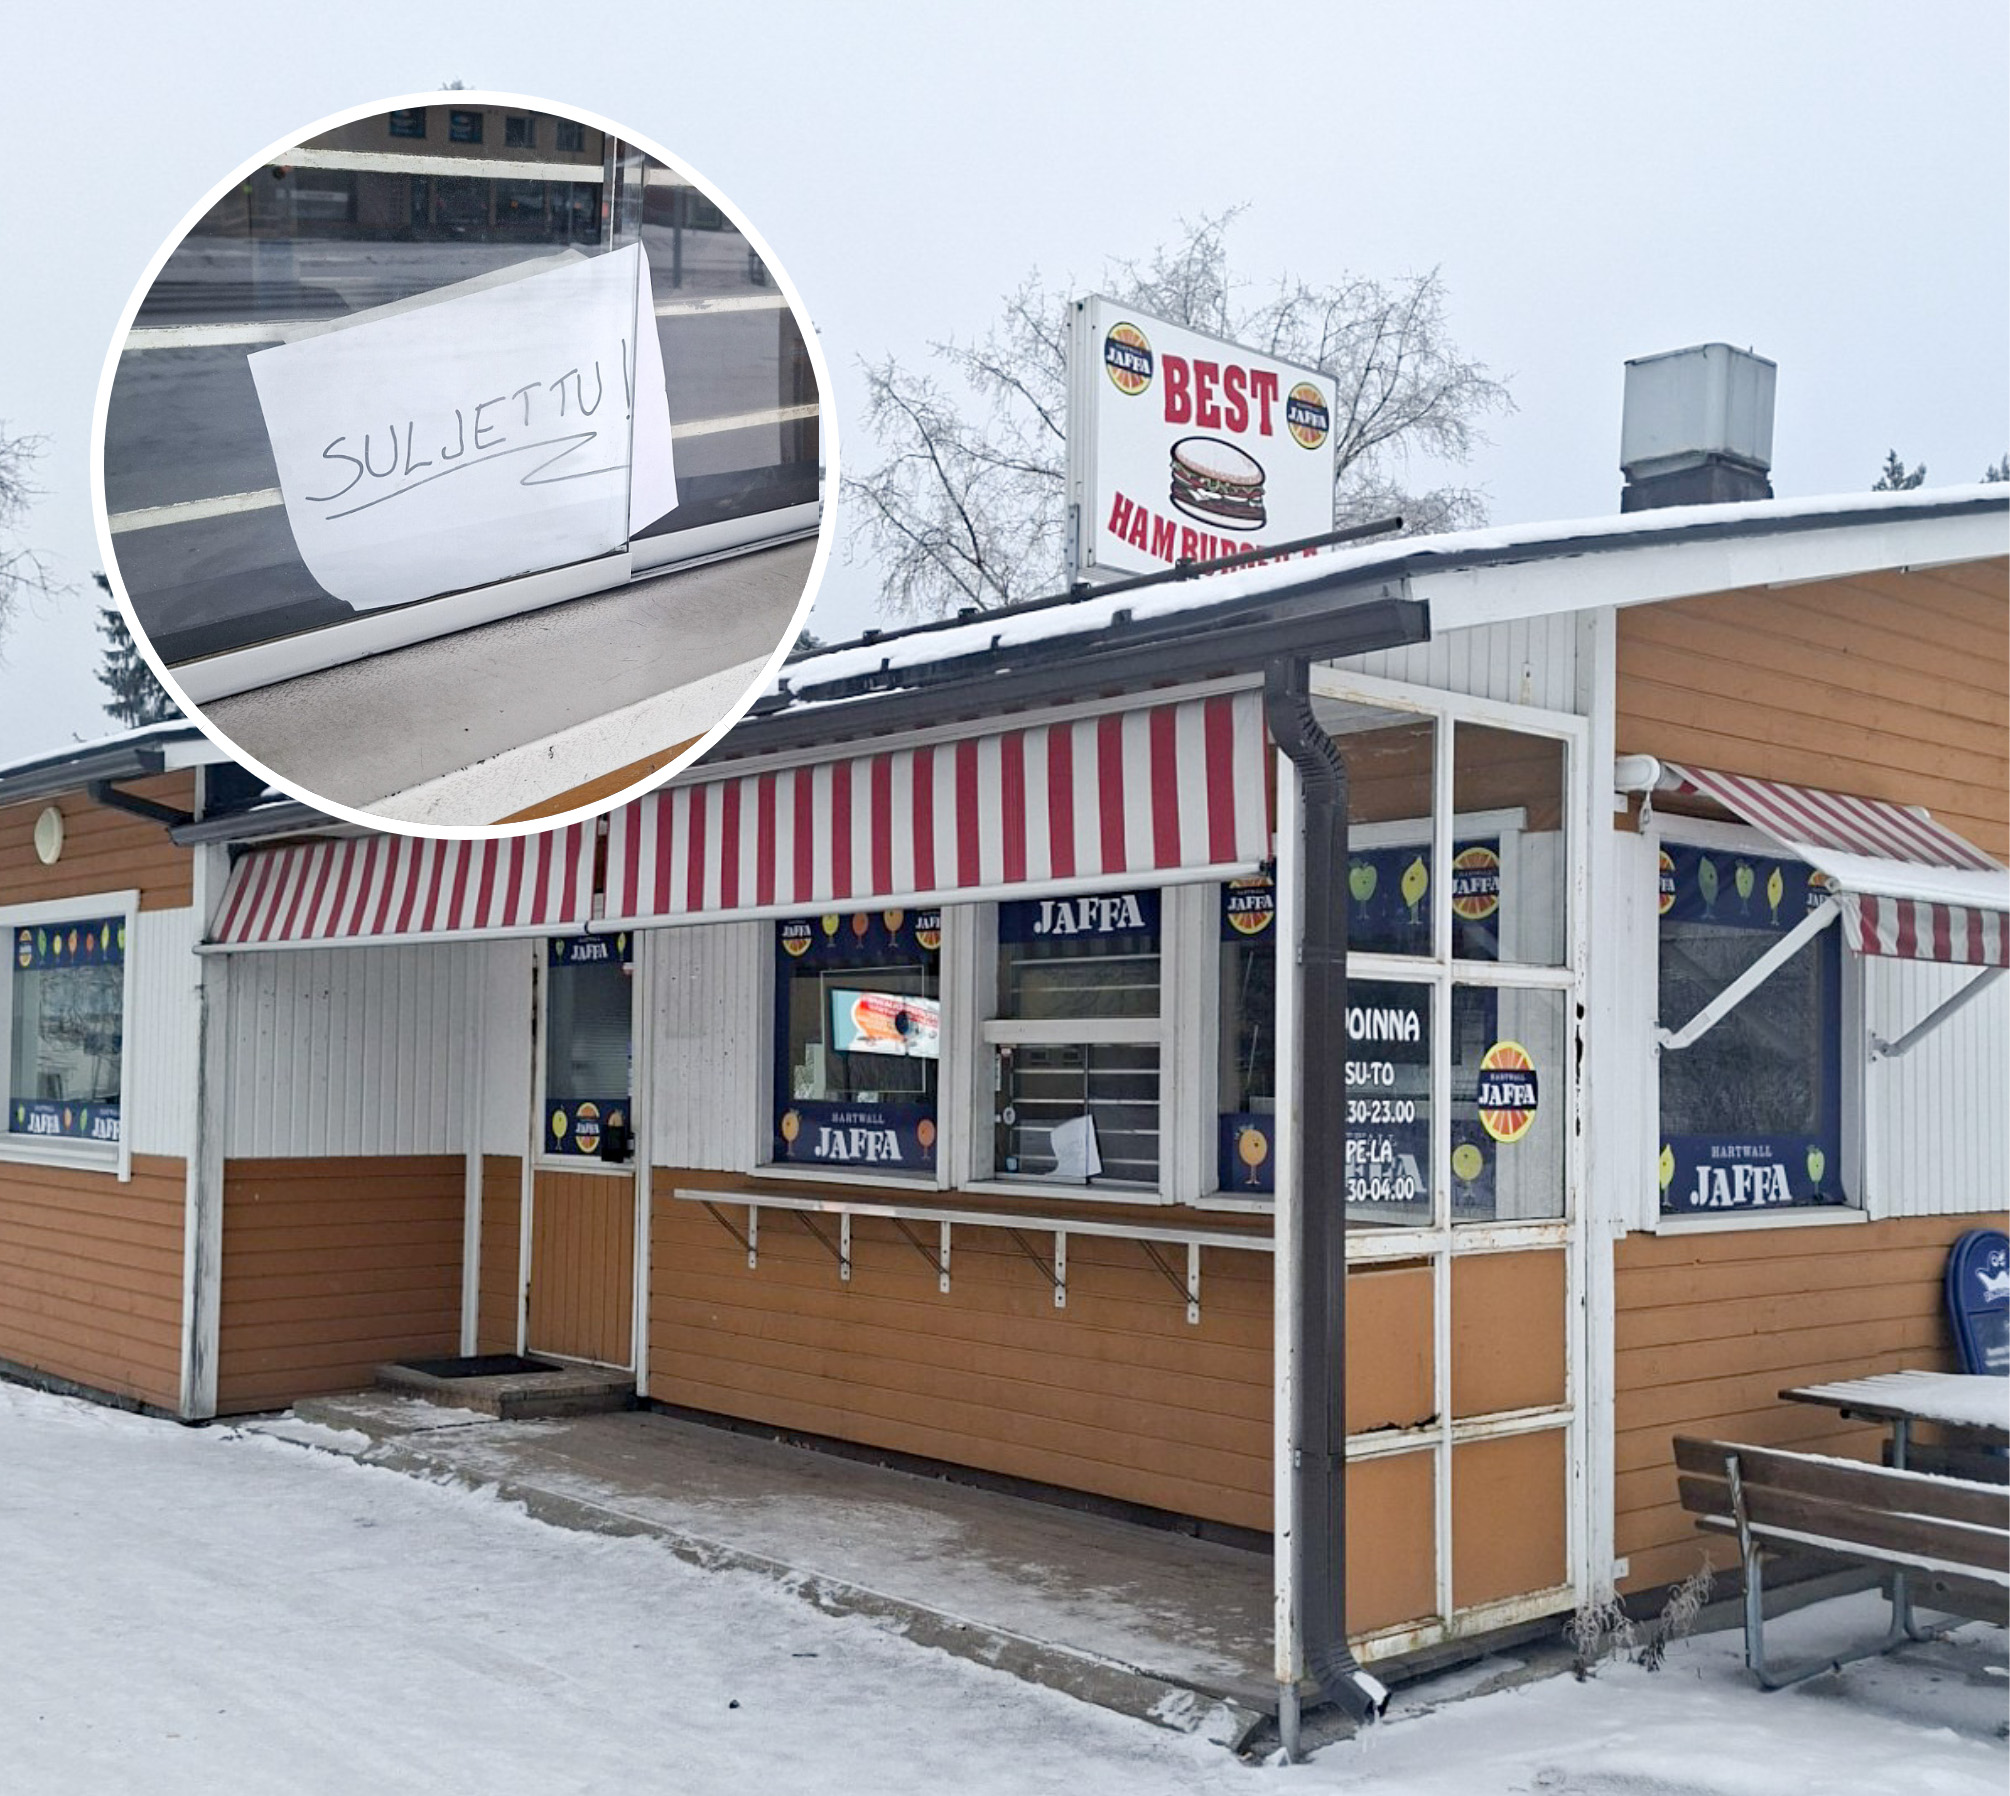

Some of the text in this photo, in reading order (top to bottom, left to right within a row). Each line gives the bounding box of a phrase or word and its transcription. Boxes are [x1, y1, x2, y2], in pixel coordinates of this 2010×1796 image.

[1106, 346, 1151, 374] JAFFA
[1161, 353, 1279, 437] BEST
[1034, 894, 1146, 935] JAFFA
[1227, 894, 1274, 911] JAFFA
[781, 924, 812, 938] JAFFA
[570, 942, 609, 961] JAFFA
[1345, 1061, 1395, 1086] SU-TO
[1478, 1083, 1536, 1106] JAFFA
[27, 1112, 61, 1134] JAFFA
[814, 1126, 903, 1162] JAFFA
[1345, 1139, 1393, 1164] PE-LA
[1711, 1144, 1773, 1159] HARTWALL
[1689, 1163, 1793, 1207] JAFFA
